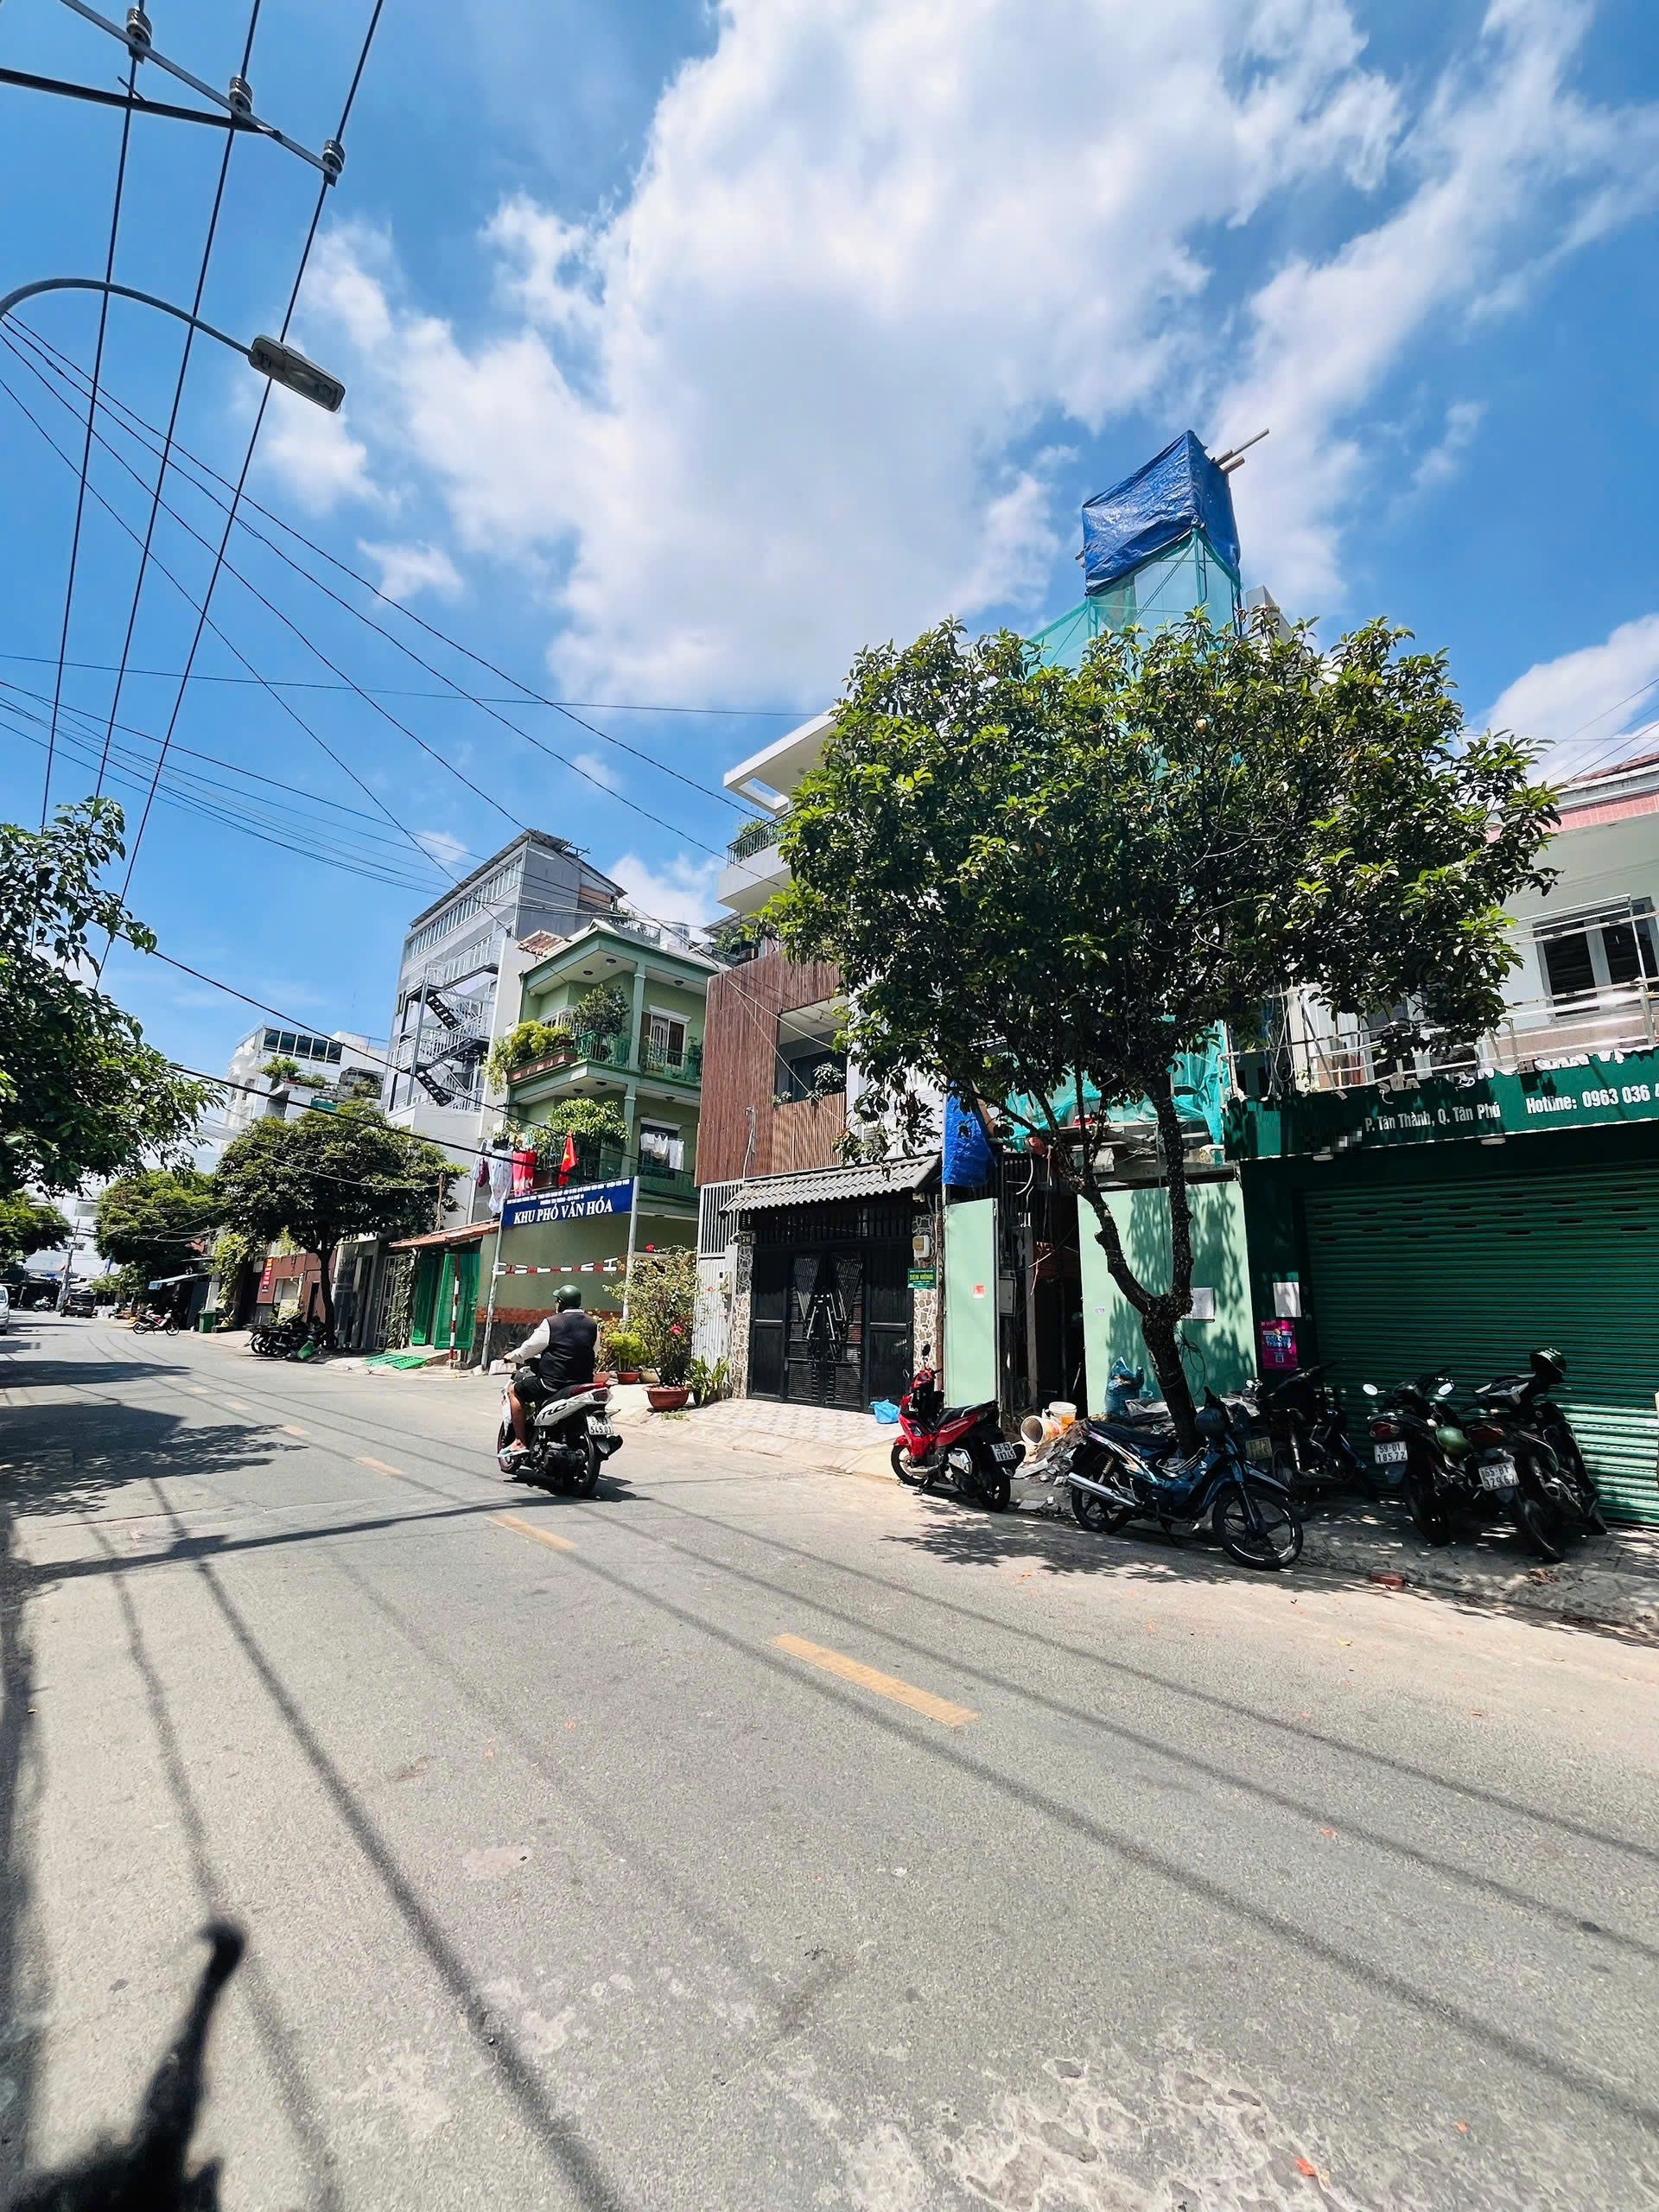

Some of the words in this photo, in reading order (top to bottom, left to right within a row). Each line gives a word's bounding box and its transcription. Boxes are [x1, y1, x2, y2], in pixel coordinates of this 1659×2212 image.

[1526, 1095, 1577, 1114] Hotline:
[1582, 1087, 1619, 1108] 0963
[1622, 1084, 1651, 1103] 036
[1365, 1117, 1376, 1132] P.
[1377, 1114, 1395, 1131] Tân
[1398, 1111, 1434, 1128] Thành,
[1438, 1108, 1450, 1126] Q.
[1452, 1106, 1474, 1122] Tân
[1477, 1101, 1502, 1120] Phú
[513, 1211, 536, 1224] KHU
[561, 1200, 584, 1218] VĂN
[586, 1195, 613, 1216] HÓA
